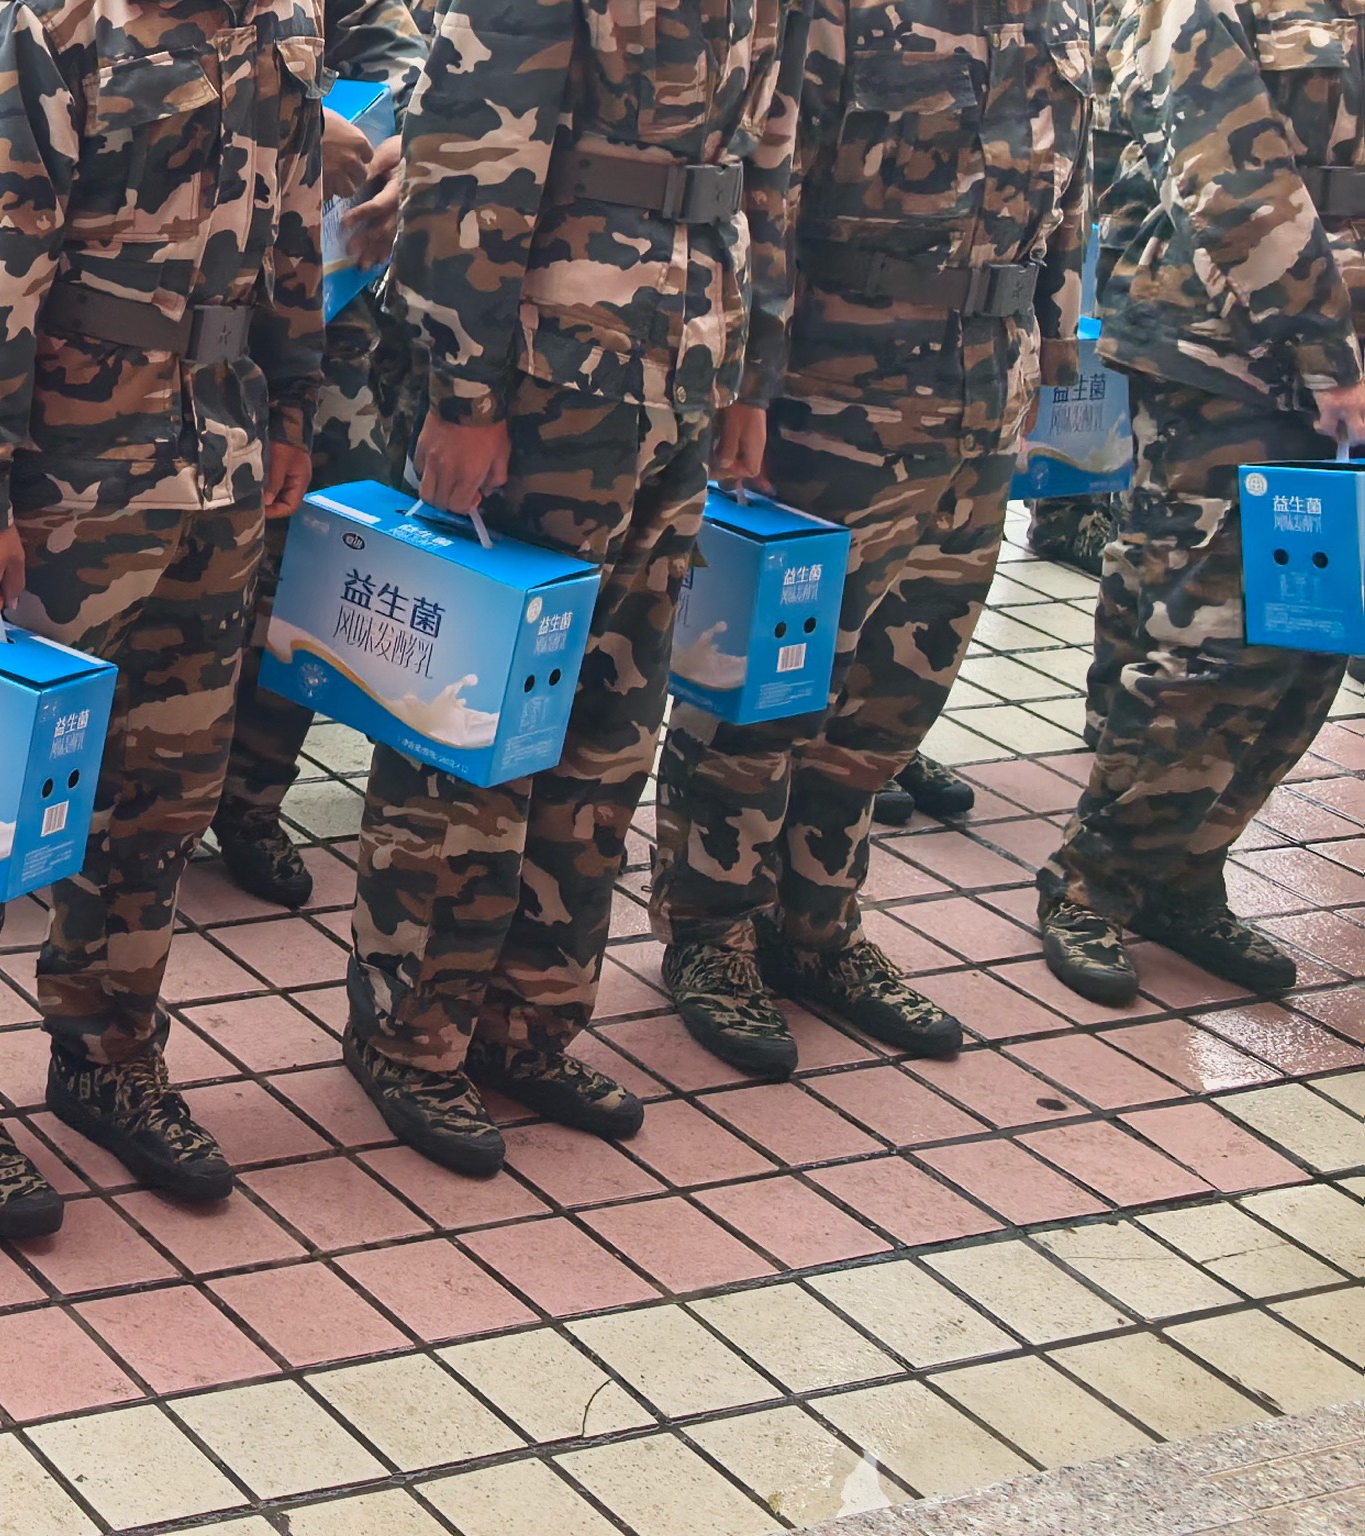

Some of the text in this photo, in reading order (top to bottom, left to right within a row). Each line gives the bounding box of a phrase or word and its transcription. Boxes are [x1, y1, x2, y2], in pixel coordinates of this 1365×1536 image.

[1272, 494, 1323, 516] 益生菌
[782, 564, 824, 586] 益生菌
[339, 568, 446, 639] 益生菌
[332, 604, 434, 680] 风味发酵乳
[53, 709, 91, 738] 益生菌
